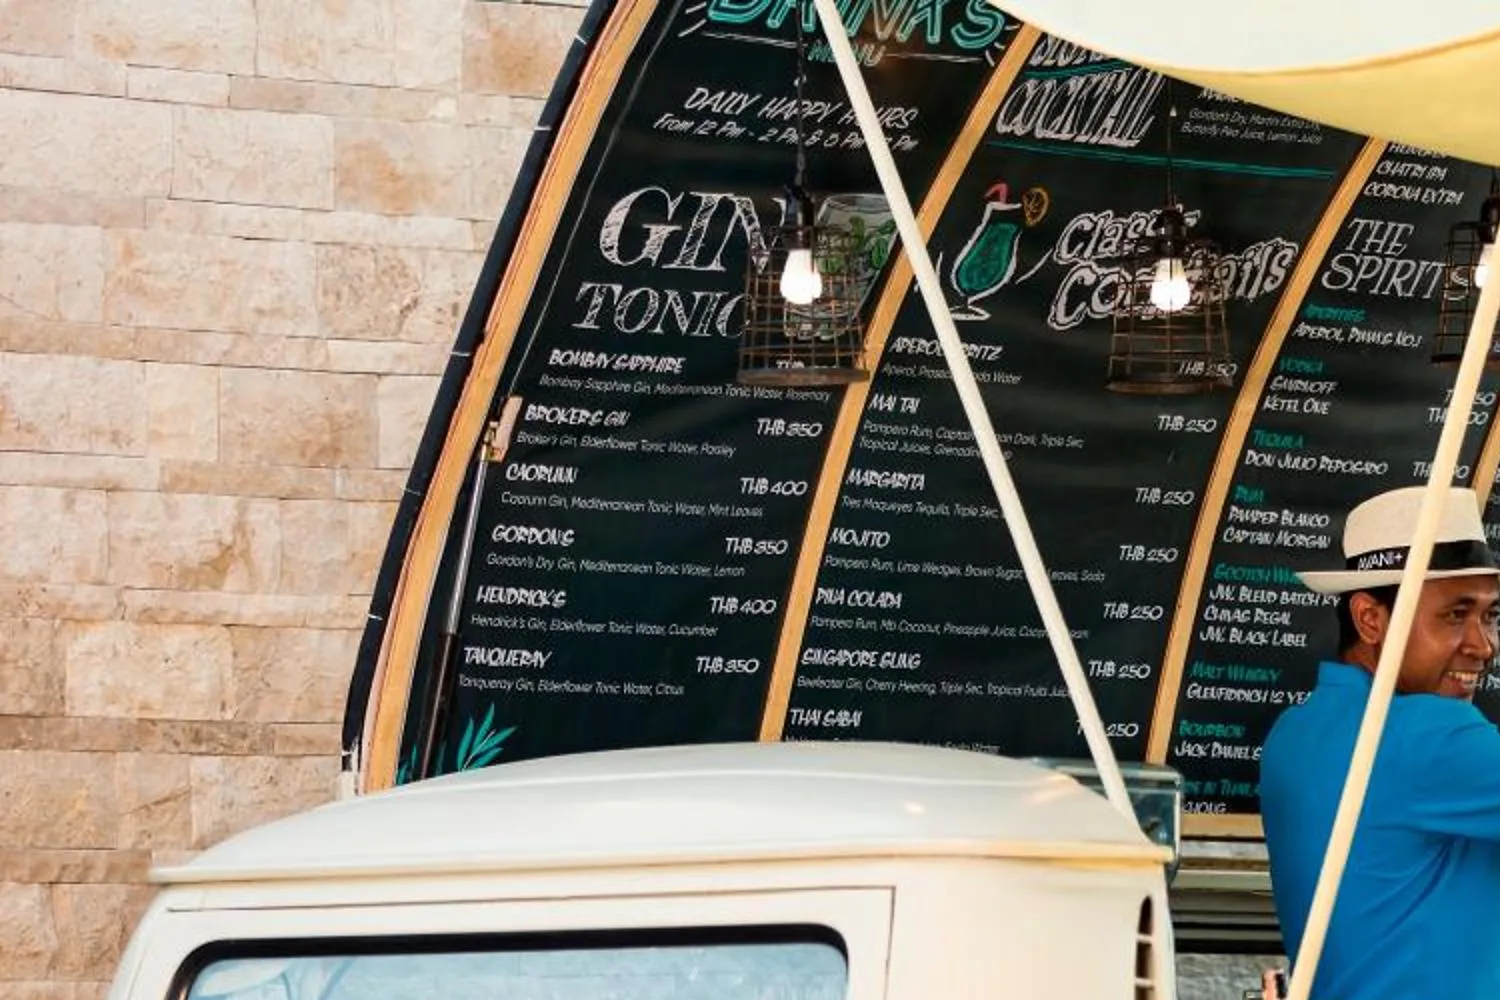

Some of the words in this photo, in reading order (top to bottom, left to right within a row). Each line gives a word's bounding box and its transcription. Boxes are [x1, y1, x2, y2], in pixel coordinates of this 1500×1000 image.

[684, 87, 758, 116] DAILY
[758, 97, 842, 123] HAPPY
[997, 67, 1166, 147] COCKTAIL
[599, 186, 787, 274] GIN
[1345, 217, 1414, 256] THE
[1048, 238, 1299, 330] Coails
[1321, 253, 1470, 301] SPIRITS
[572, 283, 752, 338] TONIC
[549, 349, 609, 369] BOMBAY
[612, 354, 686, 375] SAPPHIRE
[756, 417, 784, 436] THB
[1157, 415, 1184, 432] THB
[740, 477, 768, 496] THB
[770, 480, 808, 496] 400
[1135, 487, 1162, 504] THB
[724, 537, 752, 554] THB
[829, 528, 890, 549] MOJITO
[1119, 546, 1145, 562] THB
[709, 597, 739, 615] THB
[740, 598, 777, 615] 400
[848, 589, 901, 609] COLADA
[1103, 602, 1128, 618] THB
[1273, 630, 1308, 647] LABEL
[696, 656, 724, 673] THB
[1089, 660, 1116, 677] THB
[790, 708, 821, 726] THAI
[1175, 740, 1209, 758] JACK
